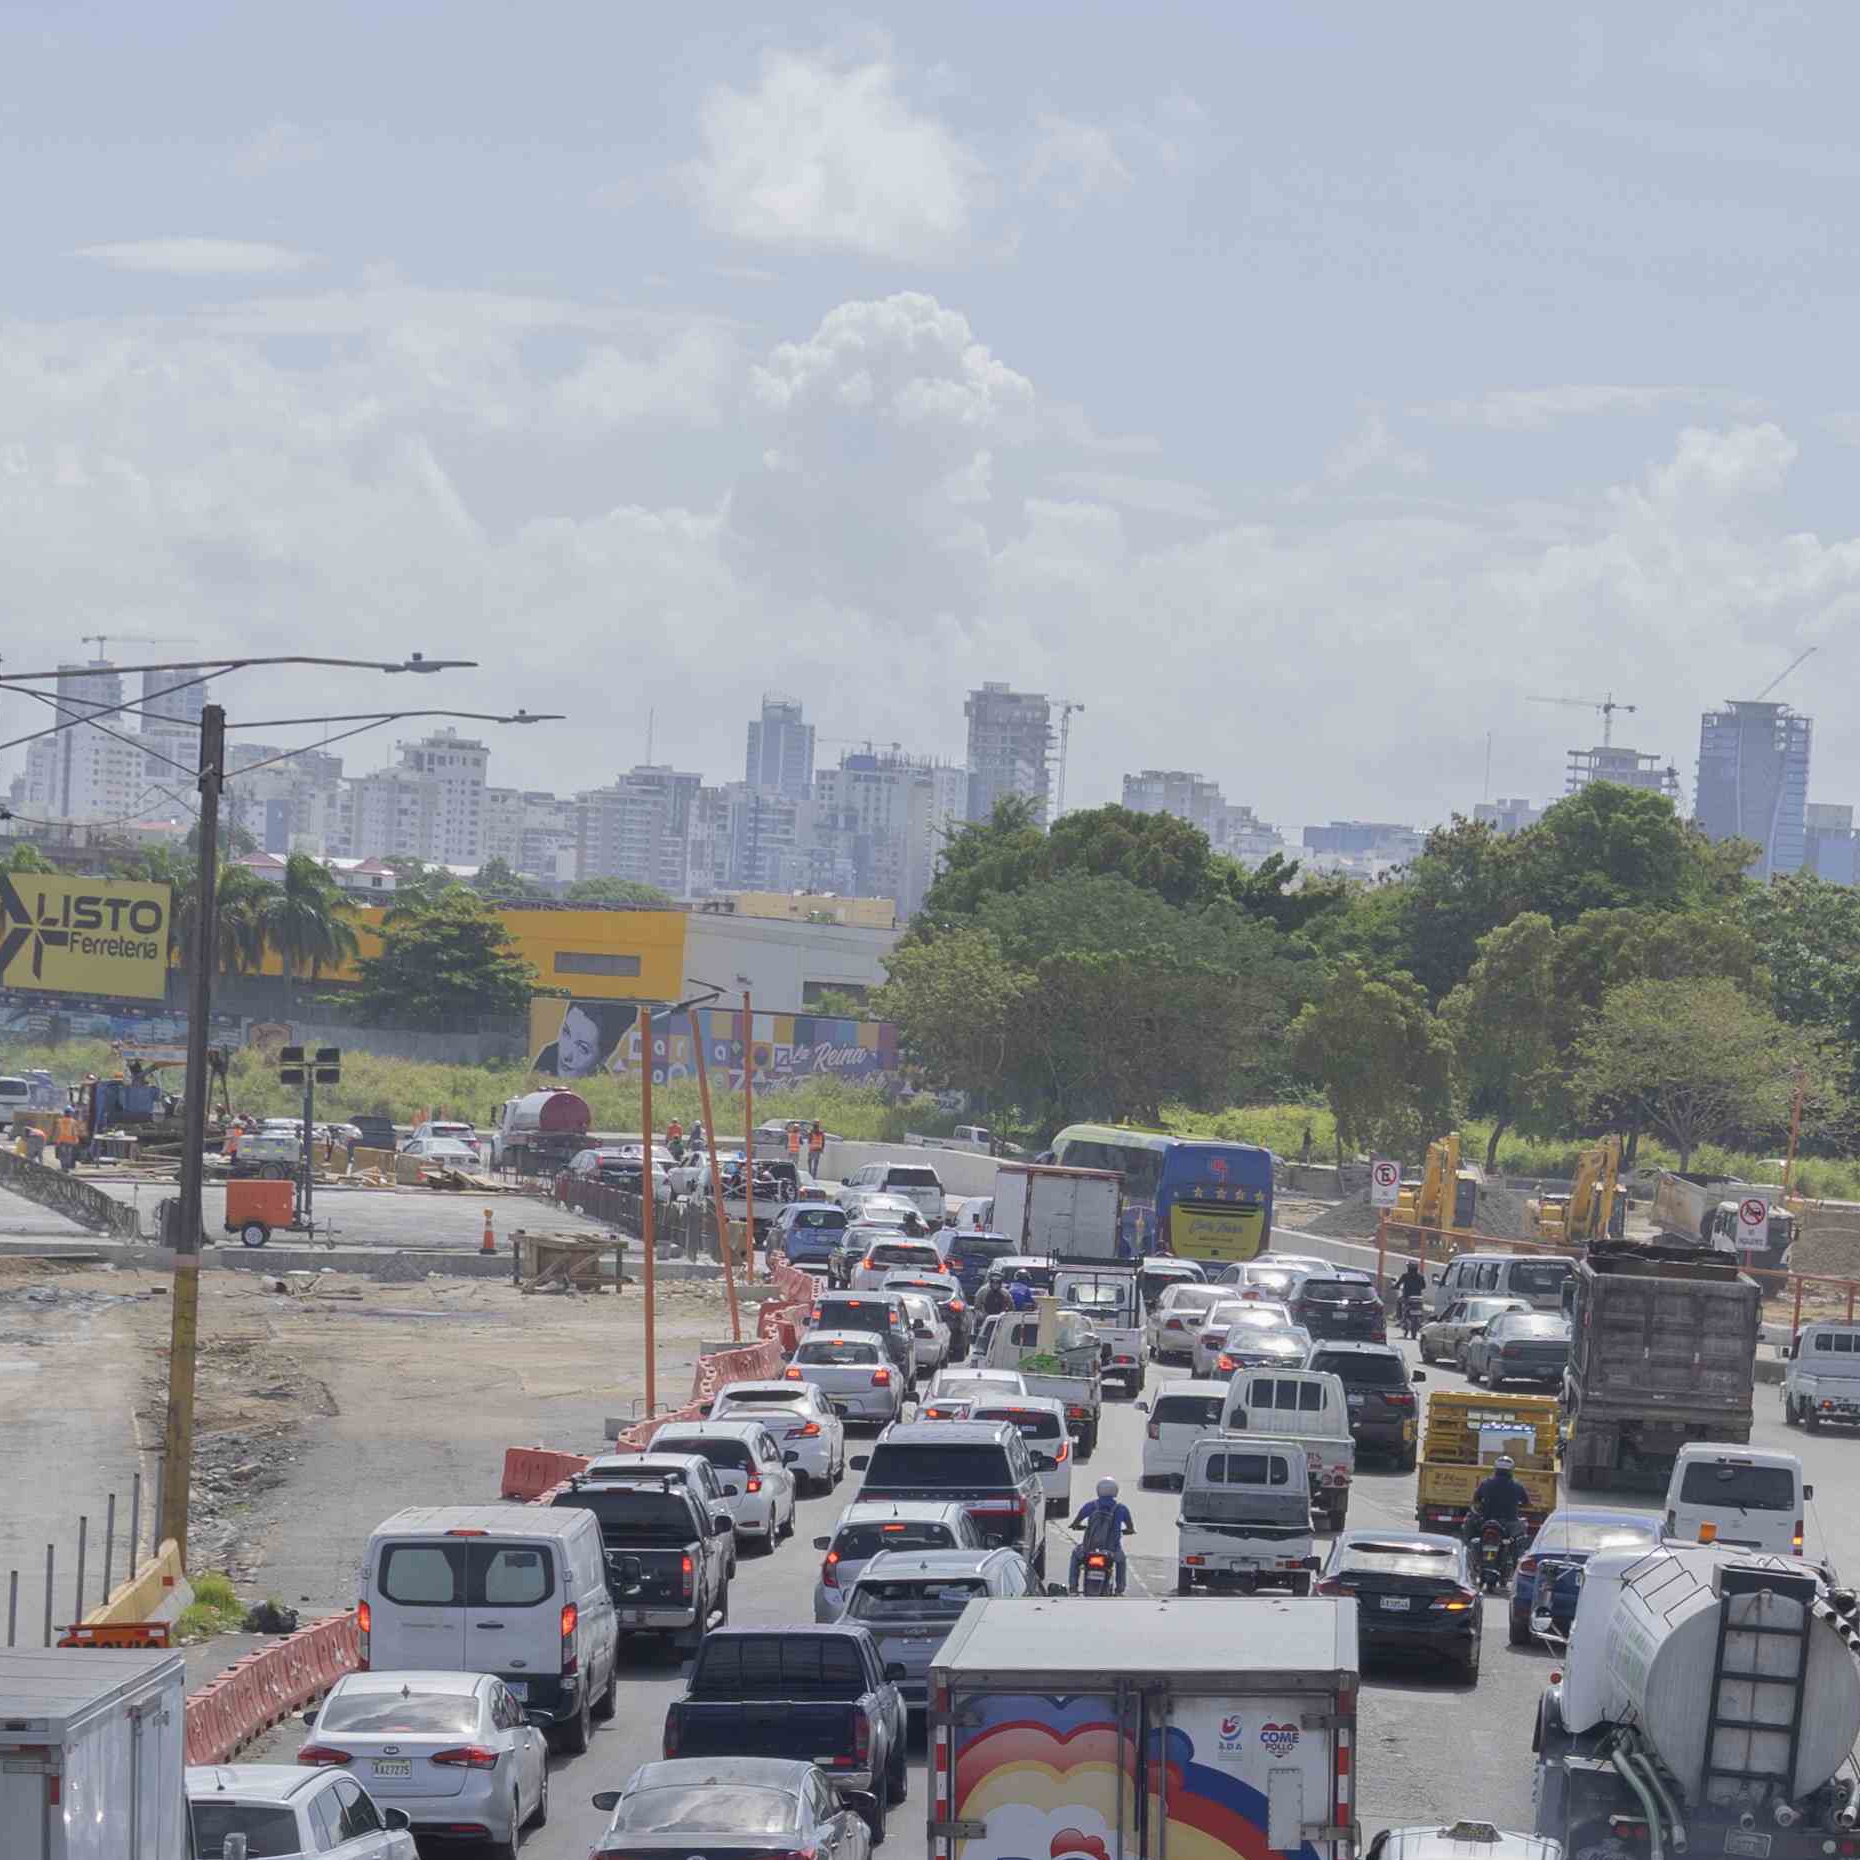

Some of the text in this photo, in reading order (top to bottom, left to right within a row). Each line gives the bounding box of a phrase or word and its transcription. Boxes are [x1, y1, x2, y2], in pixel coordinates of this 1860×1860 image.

[38, 893, 163, 934] LISTO
[1260, 1732, 1300, 1743] COME
[1265, 1743, 1294, 1751] POLLO
